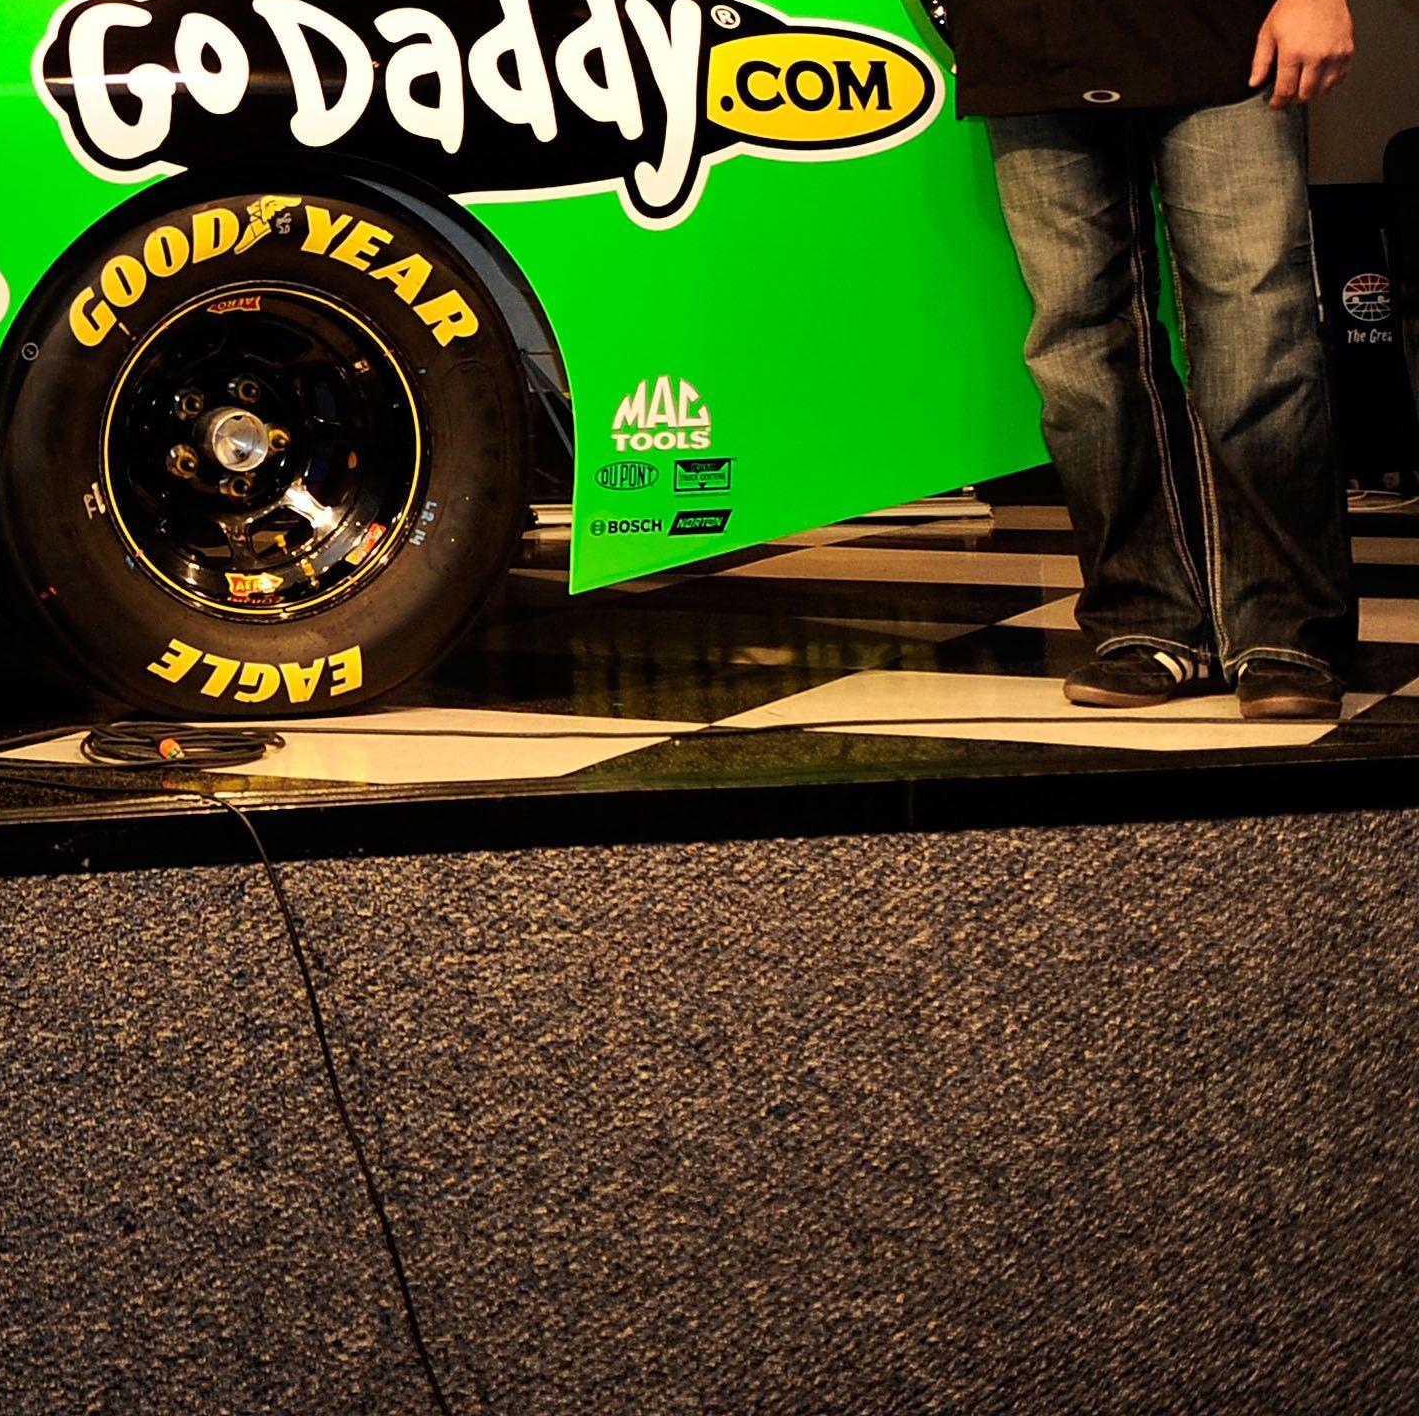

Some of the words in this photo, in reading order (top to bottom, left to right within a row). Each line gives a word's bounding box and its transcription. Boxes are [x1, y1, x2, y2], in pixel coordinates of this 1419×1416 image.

[69, 0, 249, 161] Go
[719, 59, 899, 114] .COM
[612, 375, 711, 429] MAC
[611, 431, 712, 452] TOOLS
[608, 519, 663, 534] BOSCH
[676, 516, 724, 529] NORTON
[147, 637, 363, 703] EAGLE
